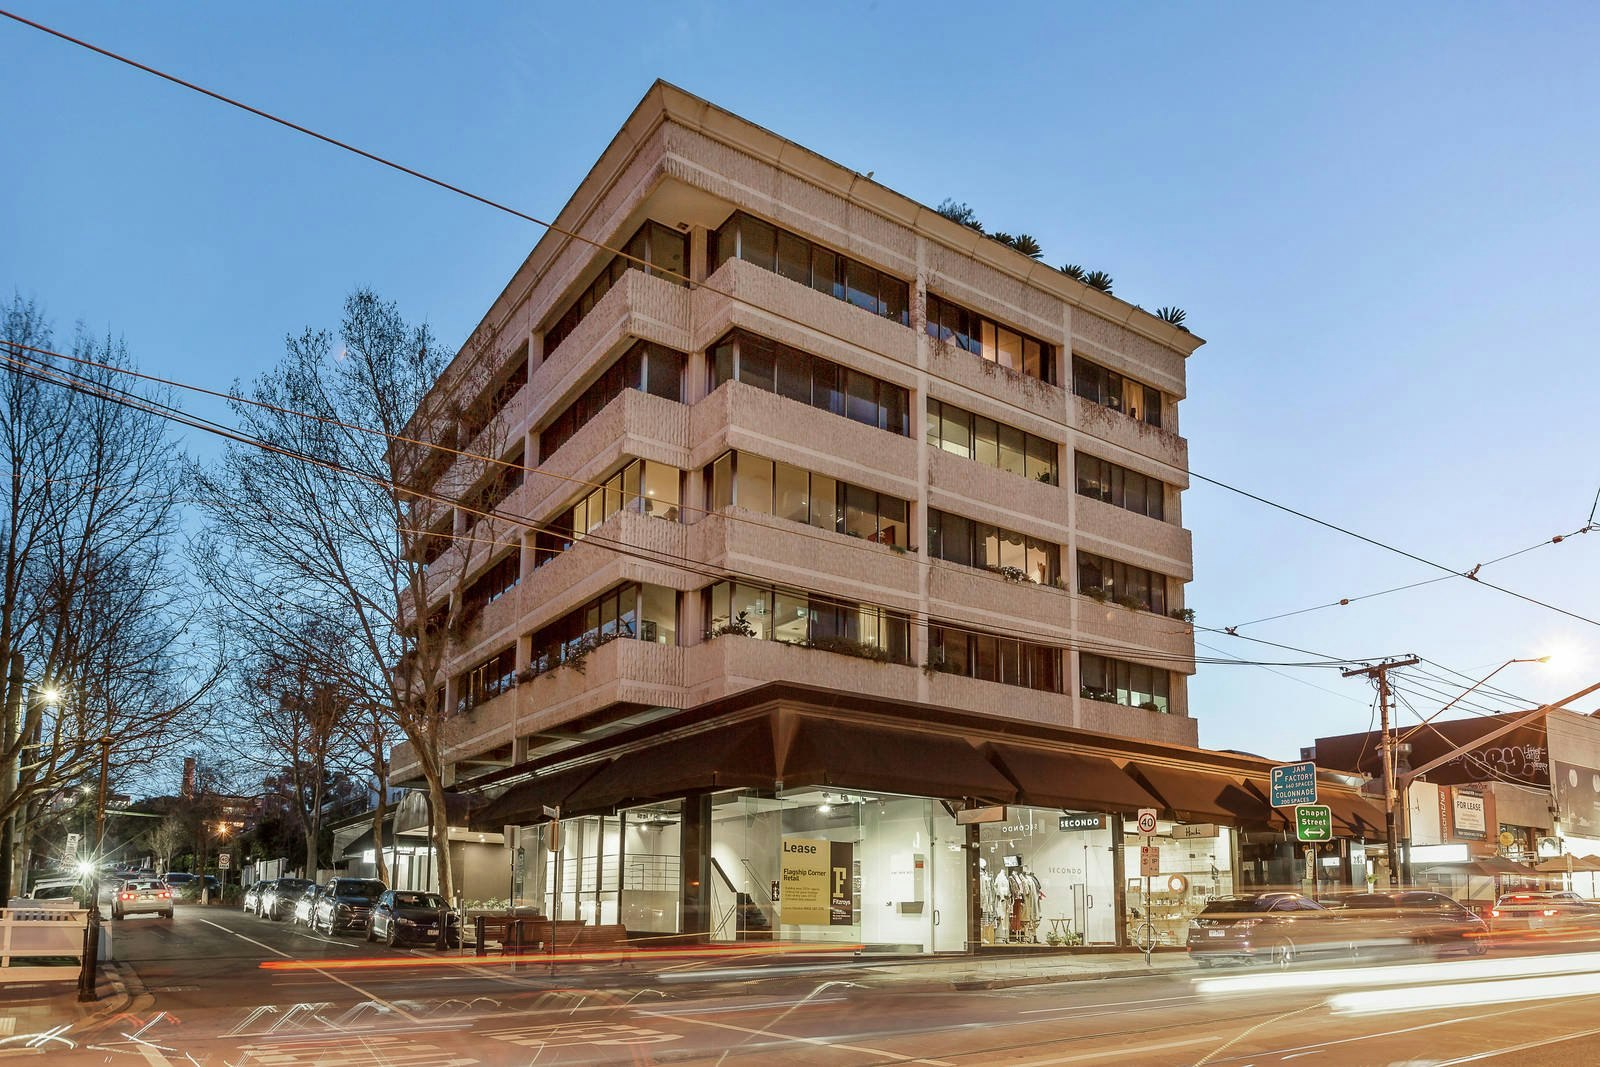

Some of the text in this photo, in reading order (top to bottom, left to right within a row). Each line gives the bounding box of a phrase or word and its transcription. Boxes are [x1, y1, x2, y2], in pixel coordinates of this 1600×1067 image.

[1274, 770, 1283, 782] P
[1285, 773, 1313, 782] FACTORY
[1276, 789, 1314, 799] COLONNADE
[1456, 800, 1481, 811] FOR LEASE
[1300, 809, 1327, 817] Chapel
[1060, 818, 1099, 828] SECONDO
[1141, 818, 1153, 827] 40
[1301, 818, 1326, 826] Street
[783, 841, 817, 854] Lease
[783, 868, 807, 876] Flagship
[1049, 866, 1082, 875] SECONDO
